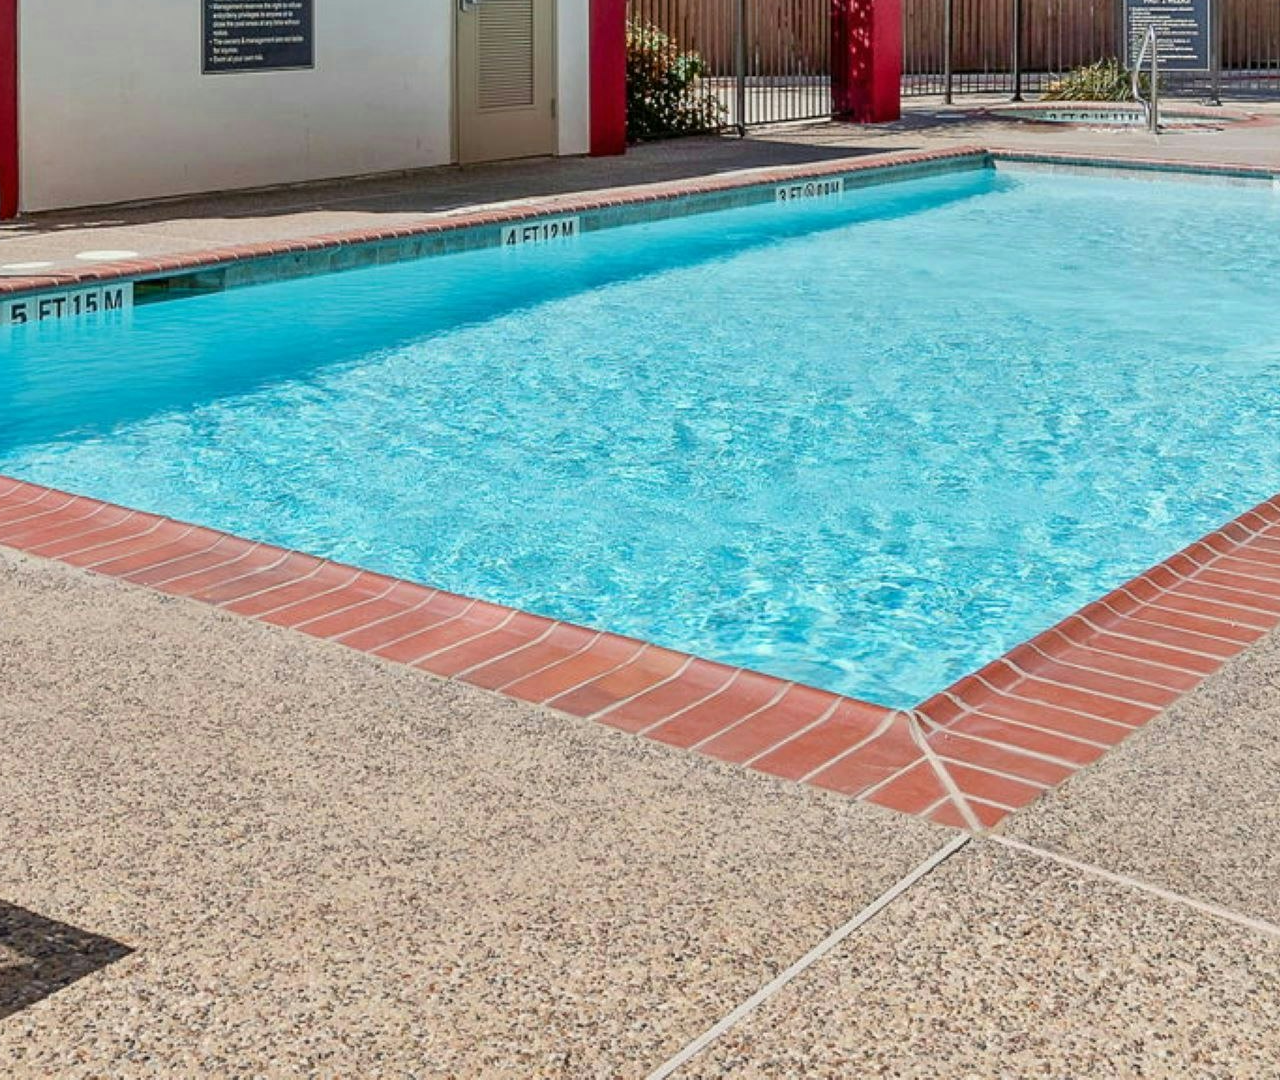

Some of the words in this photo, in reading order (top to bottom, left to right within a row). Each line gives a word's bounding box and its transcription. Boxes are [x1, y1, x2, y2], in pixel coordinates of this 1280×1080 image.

[523, 225, 539, 243] FT
[11, 304, 27, 324] 5
[39, 297, 66, 320] FT
